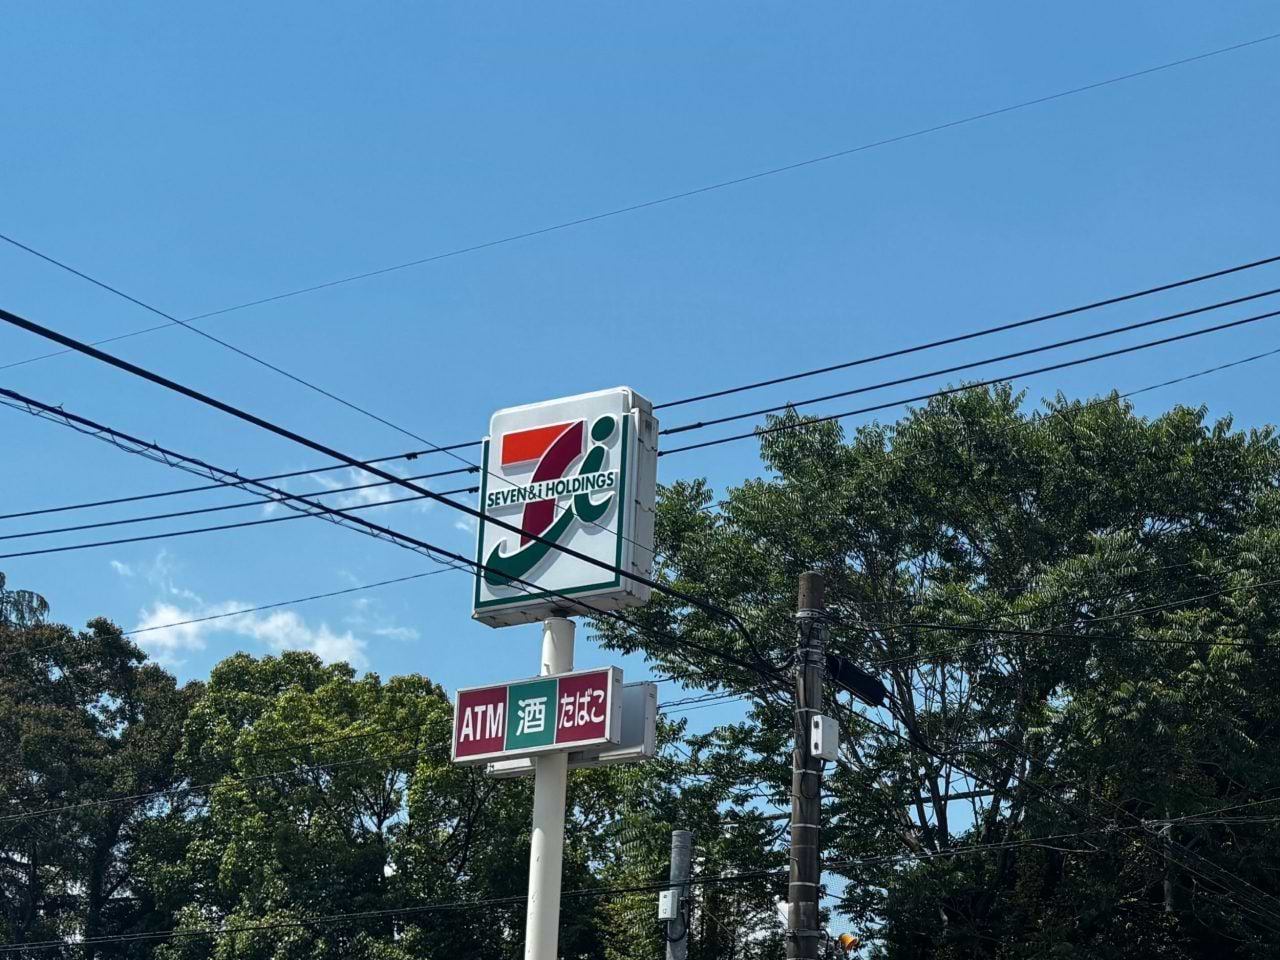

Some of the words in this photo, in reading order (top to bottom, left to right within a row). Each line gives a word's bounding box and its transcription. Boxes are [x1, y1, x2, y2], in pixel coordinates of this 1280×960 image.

[545, 471, 614, 497] HOLDINGS
[460, 702, 504, 743] ATM
[517, 695, 547, 736] 酒
[559, 688, 605, 729] たばこ
